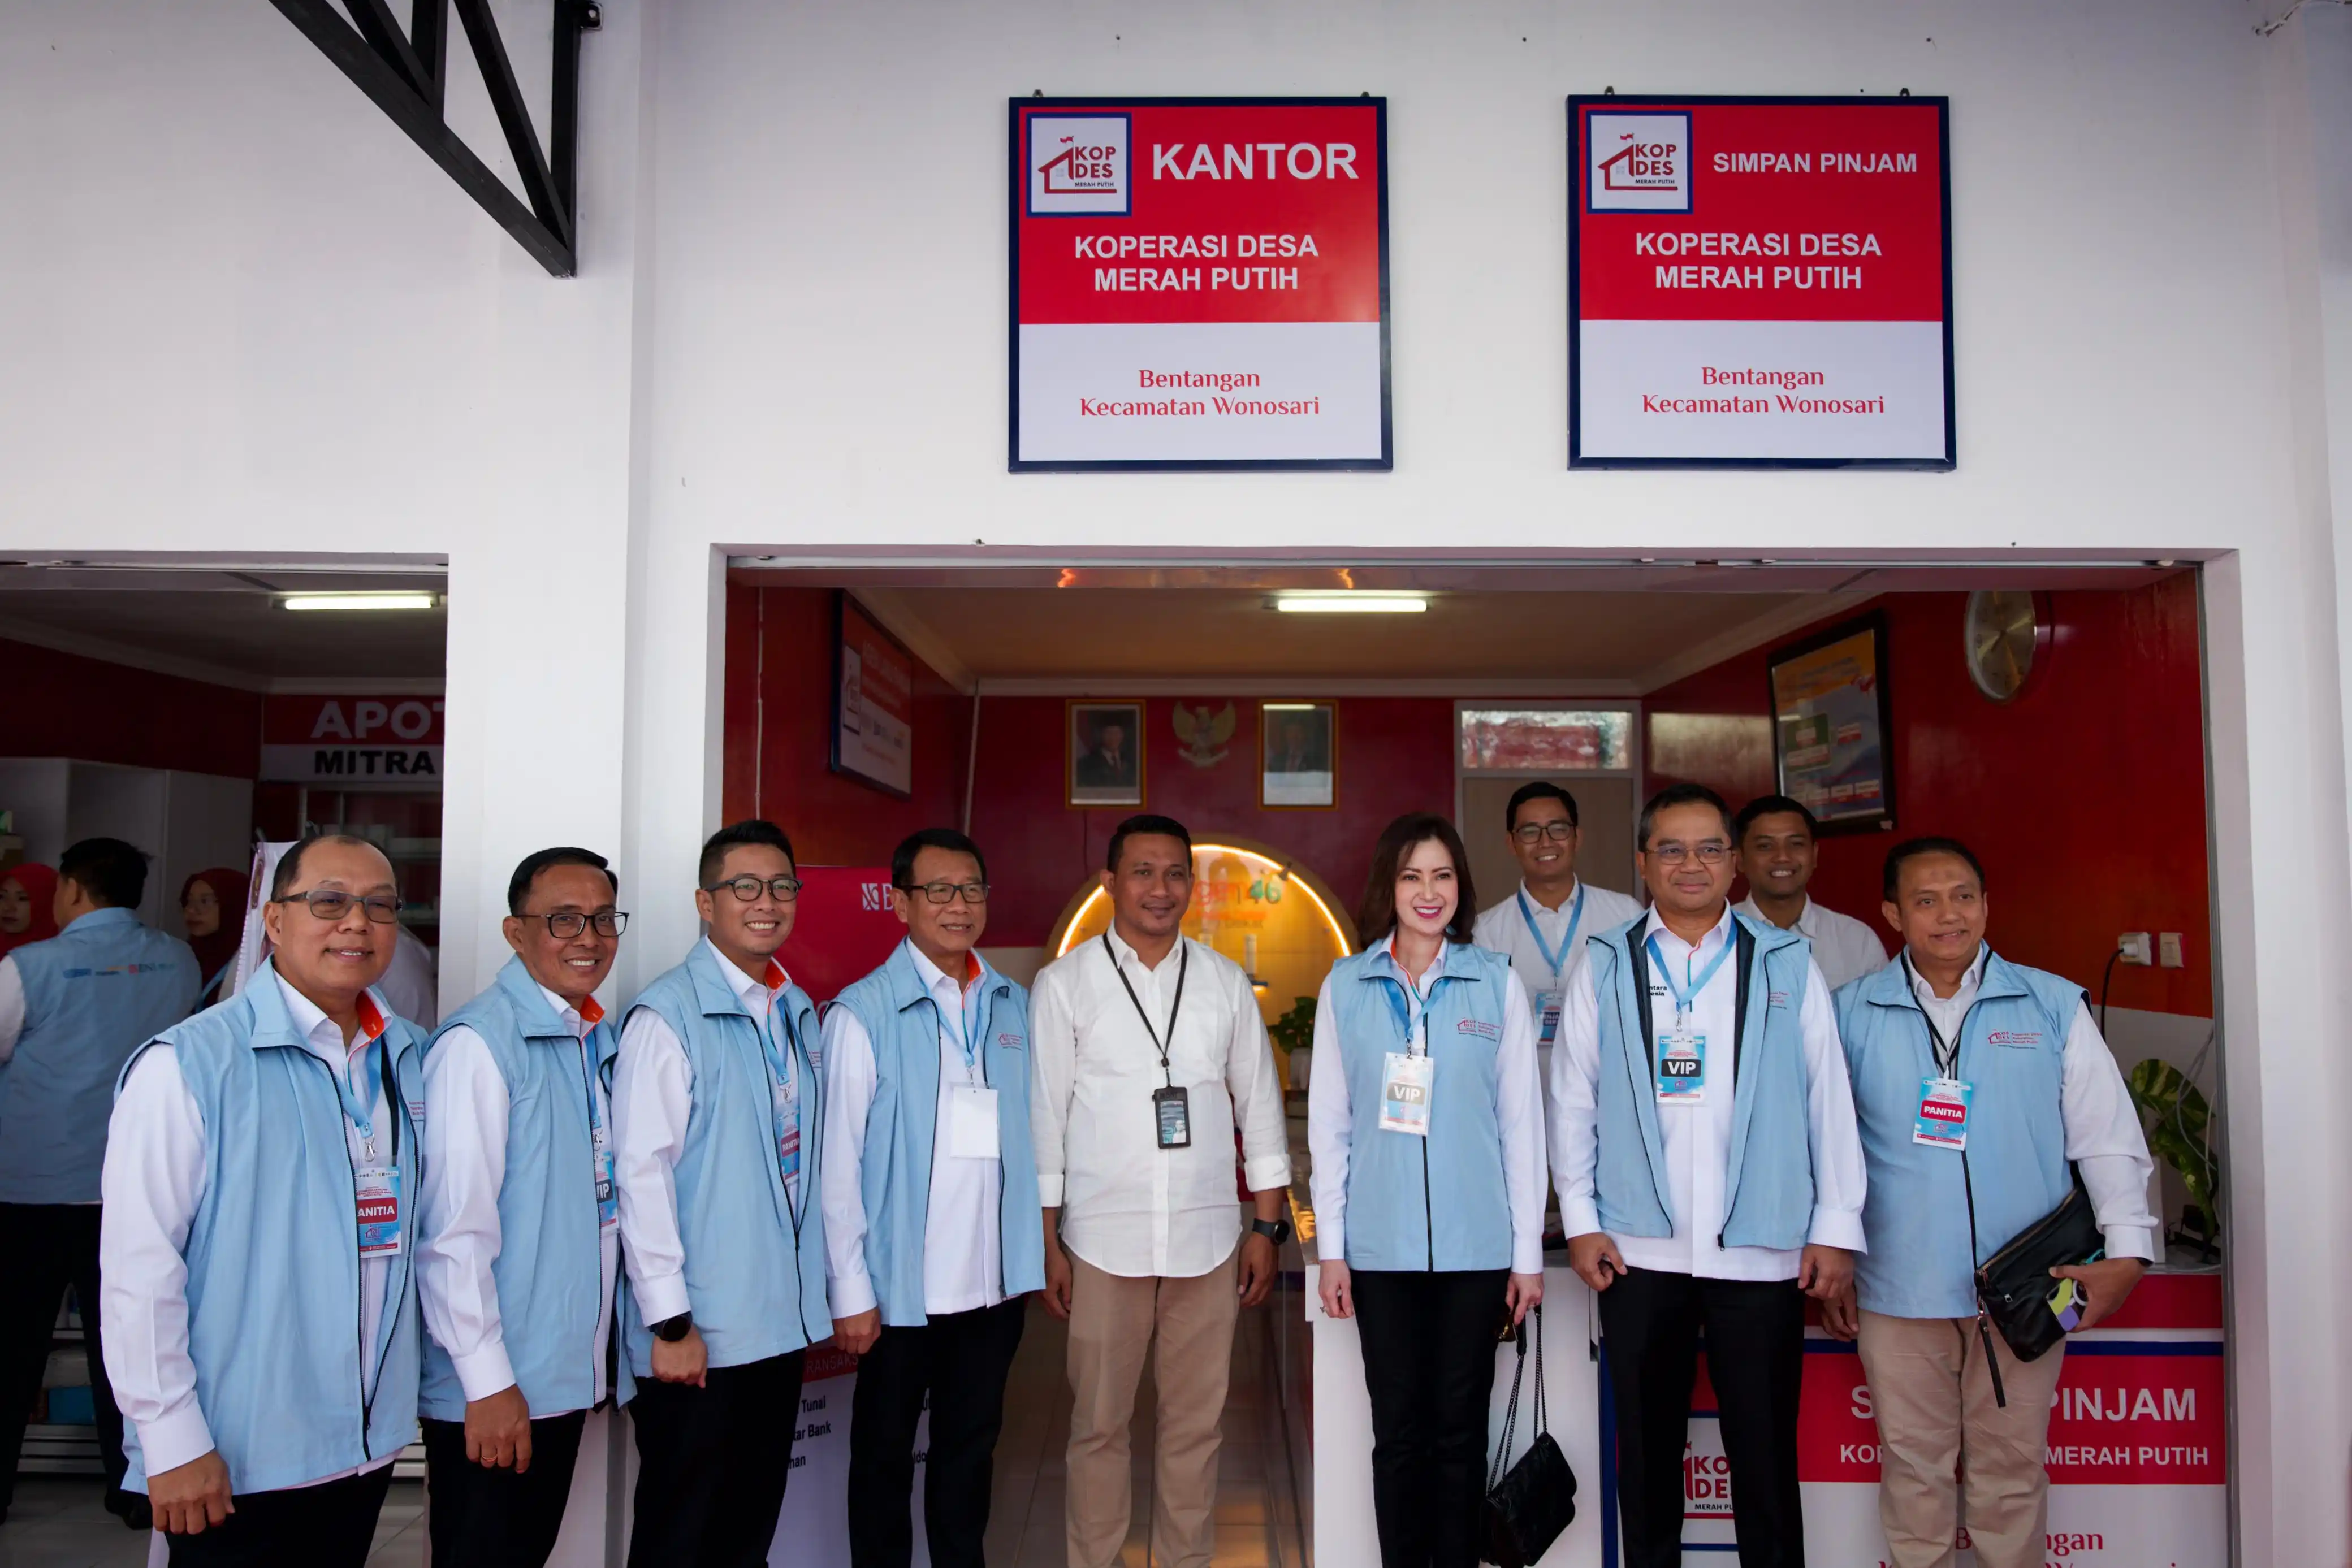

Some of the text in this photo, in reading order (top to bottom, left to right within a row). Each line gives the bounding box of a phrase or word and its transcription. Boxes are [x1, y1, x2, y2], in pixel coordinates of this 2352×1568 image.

[1075, 145, 1116, 161] KOP
[1635, 143, 1677, 158] KOP
[1075, 162, 1113, 179] DES
[1153, 142, 1359, 180] KANTOR
[1635, 160, 1674, 176] DES
[1714, 153, 1917, 173] SIMPAN PINJAM
[1075, 234, 1320, 258] KOPERASI DESA
[1636, 232, 1882, 256] KOPERASI DESA
[1095, 267, 1298, 291] MERAH PUTIH
[1655, 266, 1861, 289] MERAH PUTIH
[1139, 369, 1260, 392] Bentangan
[1701, 366, 1824, 390] Bentangan
[1080, 396, 1320, 416] Kecamatan Wonosari
[1642, 394, 1884, 414] Kecamatan Wonosari
[314, 750, 436, 775] MITRA
[1667, 1061, 1696, 1075] VIP
[1394, 1085, 1421, 1101] VIP
[1923, 1105, 1963, 1119] PANITIA
[357, 1205, 395, 1218] ANITIA
[801, 1394, 826, 1413] Tunai
[808, 1420, 831, 1437] Bank
[1694, 1456, 1731, 1475] KO
[2045, 1446, 2209, 1466] MERAH PUTIH
[1695, 1478, 1732, 1498] DE
